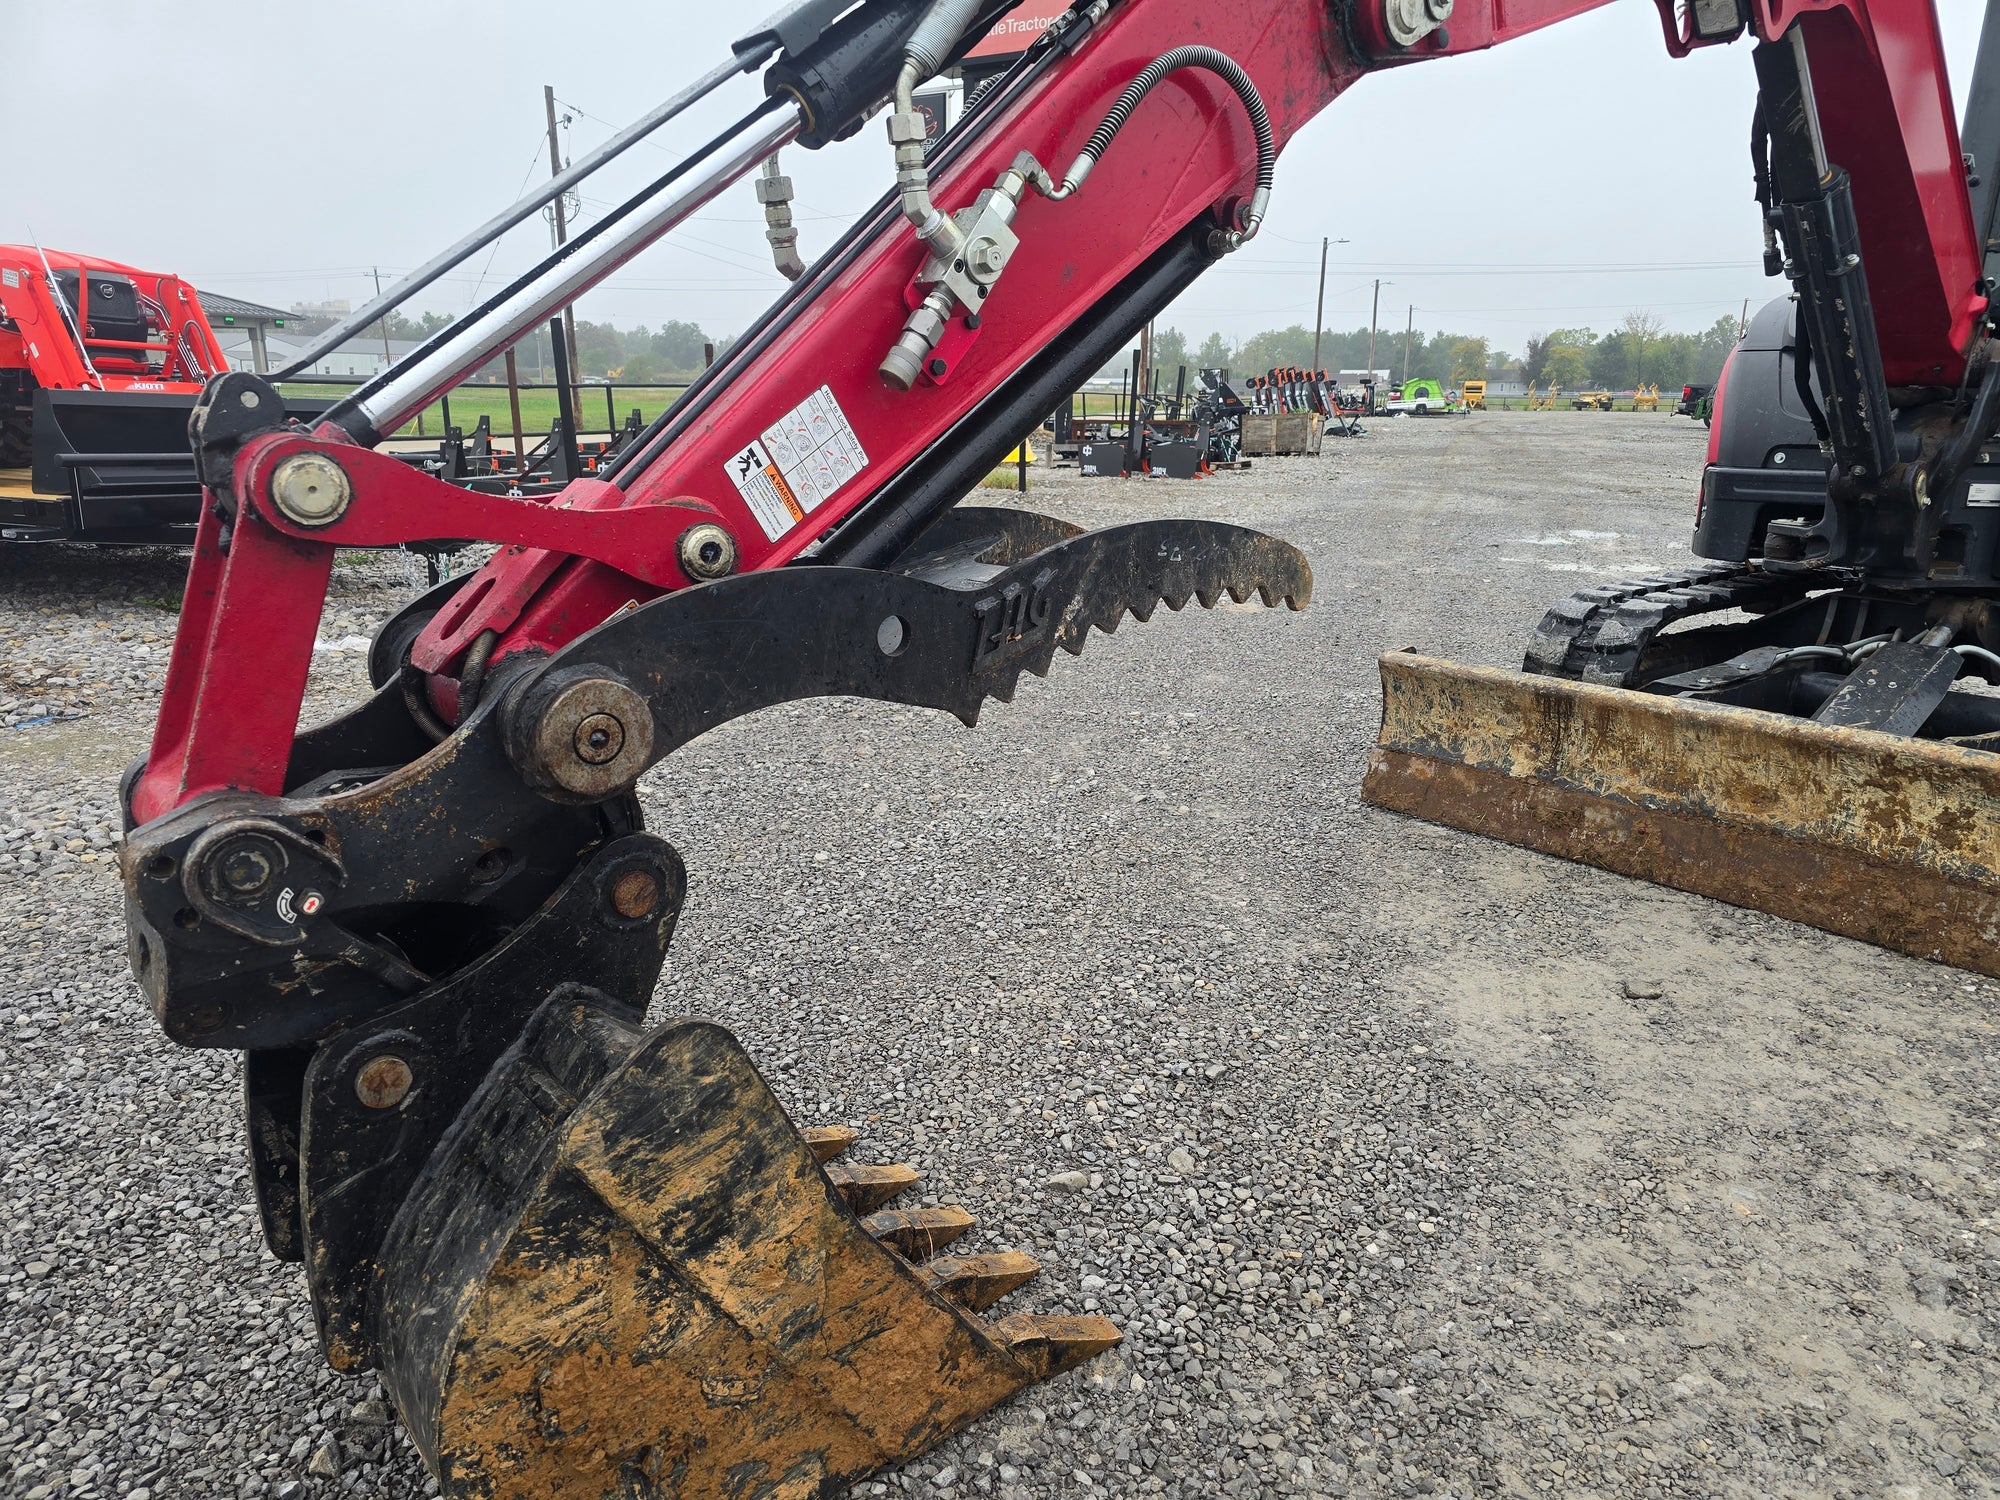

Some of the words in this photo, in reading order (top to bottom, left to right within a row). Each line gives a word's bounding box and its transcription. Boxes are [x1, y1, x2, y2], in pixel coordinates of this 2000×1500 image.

[823, 389, 834, 405] How
[832, 405, 838, 413] to
[837, 414, 848, 429] Lock
[846, 430, 860, 450] Safety
[857, 450, 865, 461] Pin
[774, 479, 798, 515] WARNING
